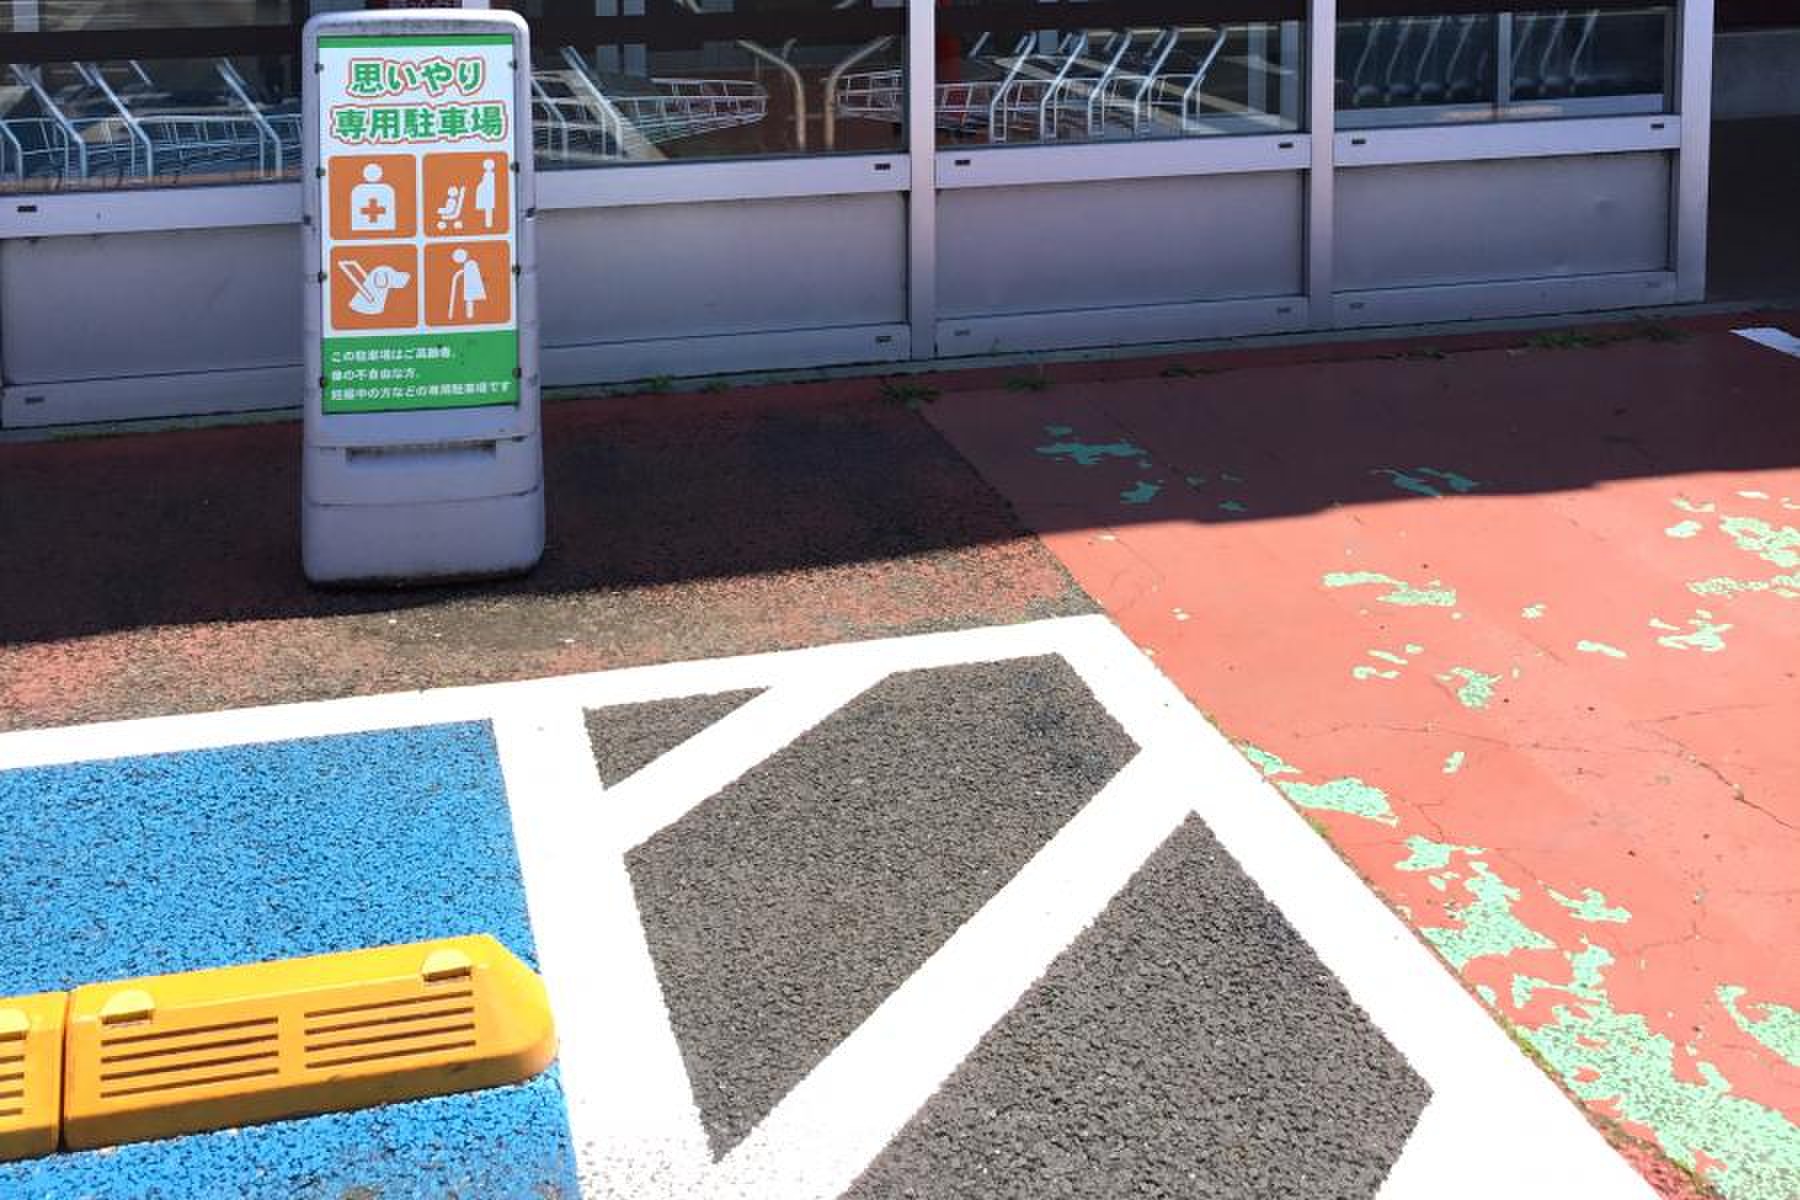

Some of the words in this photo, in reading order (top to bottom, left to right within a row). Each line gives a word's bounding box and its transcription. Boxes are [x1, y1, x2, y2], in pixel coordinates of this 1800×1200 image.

[346, 57, 486, 98] 思いやり
[331, 102, 508, 145] 専用駐車場
